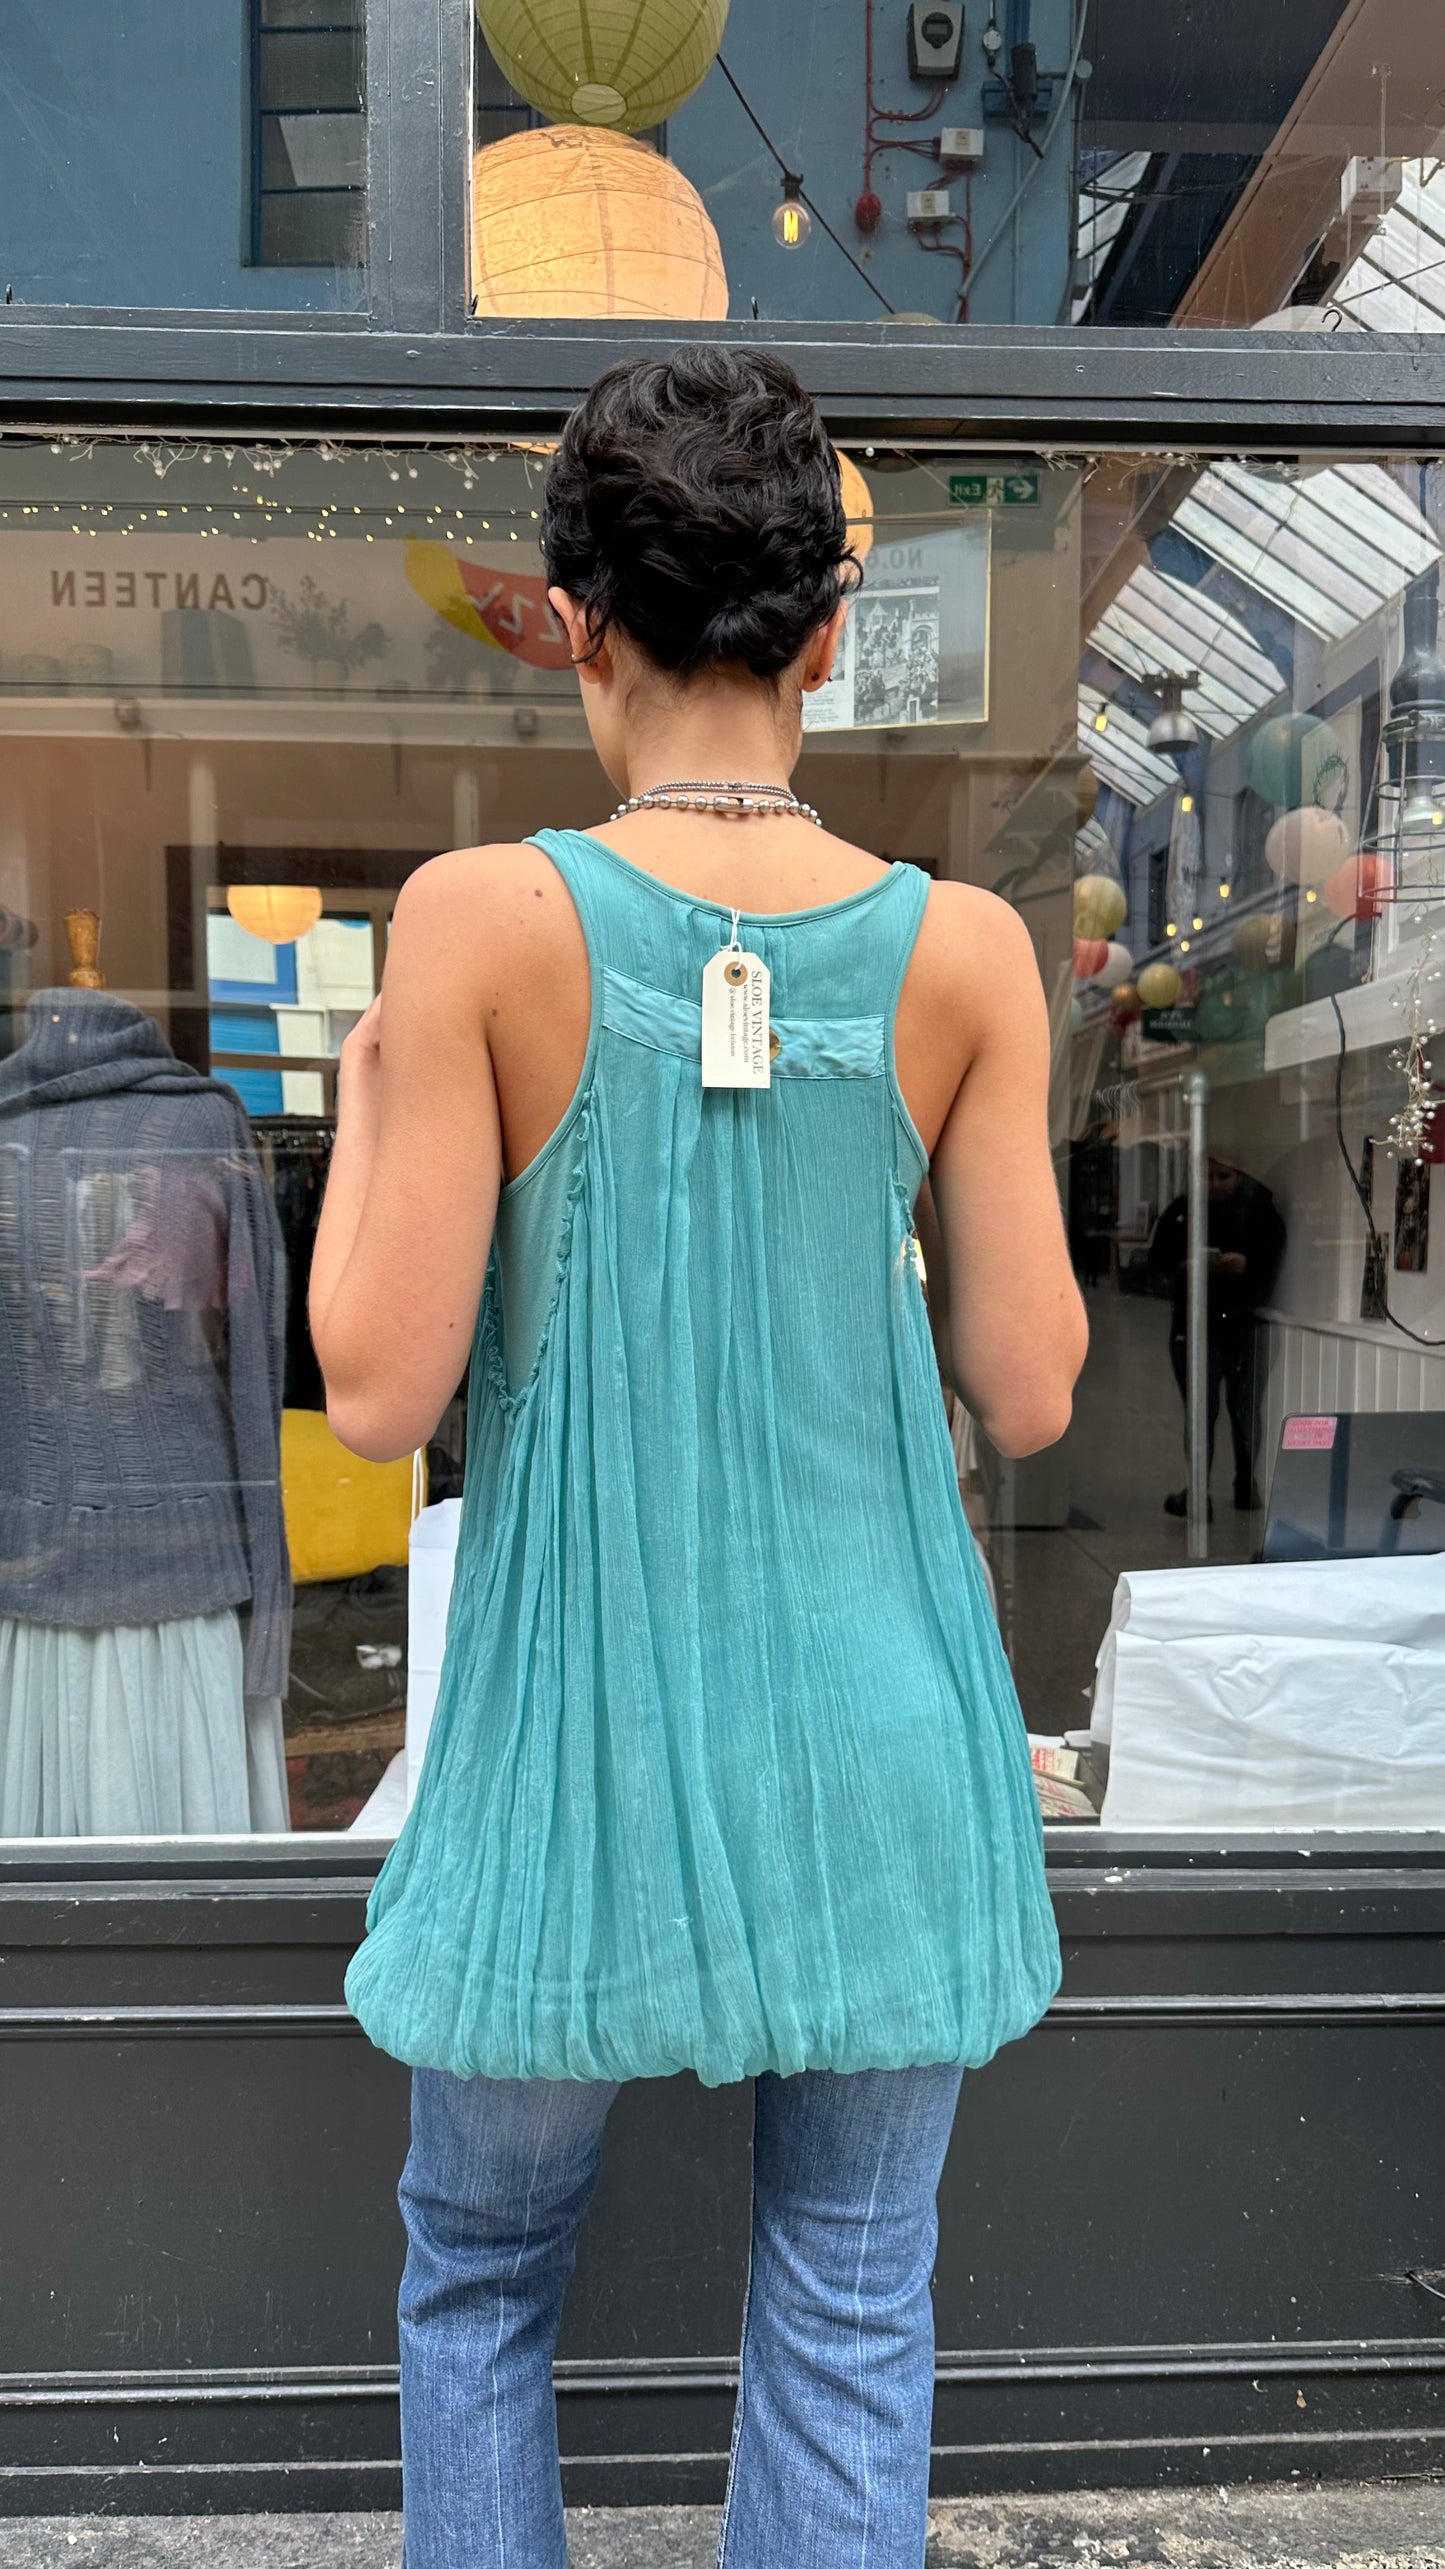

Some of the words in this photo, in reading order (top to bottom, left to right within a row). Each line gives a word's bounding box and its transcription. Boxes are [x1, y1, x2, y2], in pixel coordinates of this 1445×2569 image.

[751, 970, 763, 1007] SLOE
[742, 984, 751, 1063] www.sloevintage.com
[752, 1010, 764, 1074] VINTAGE
